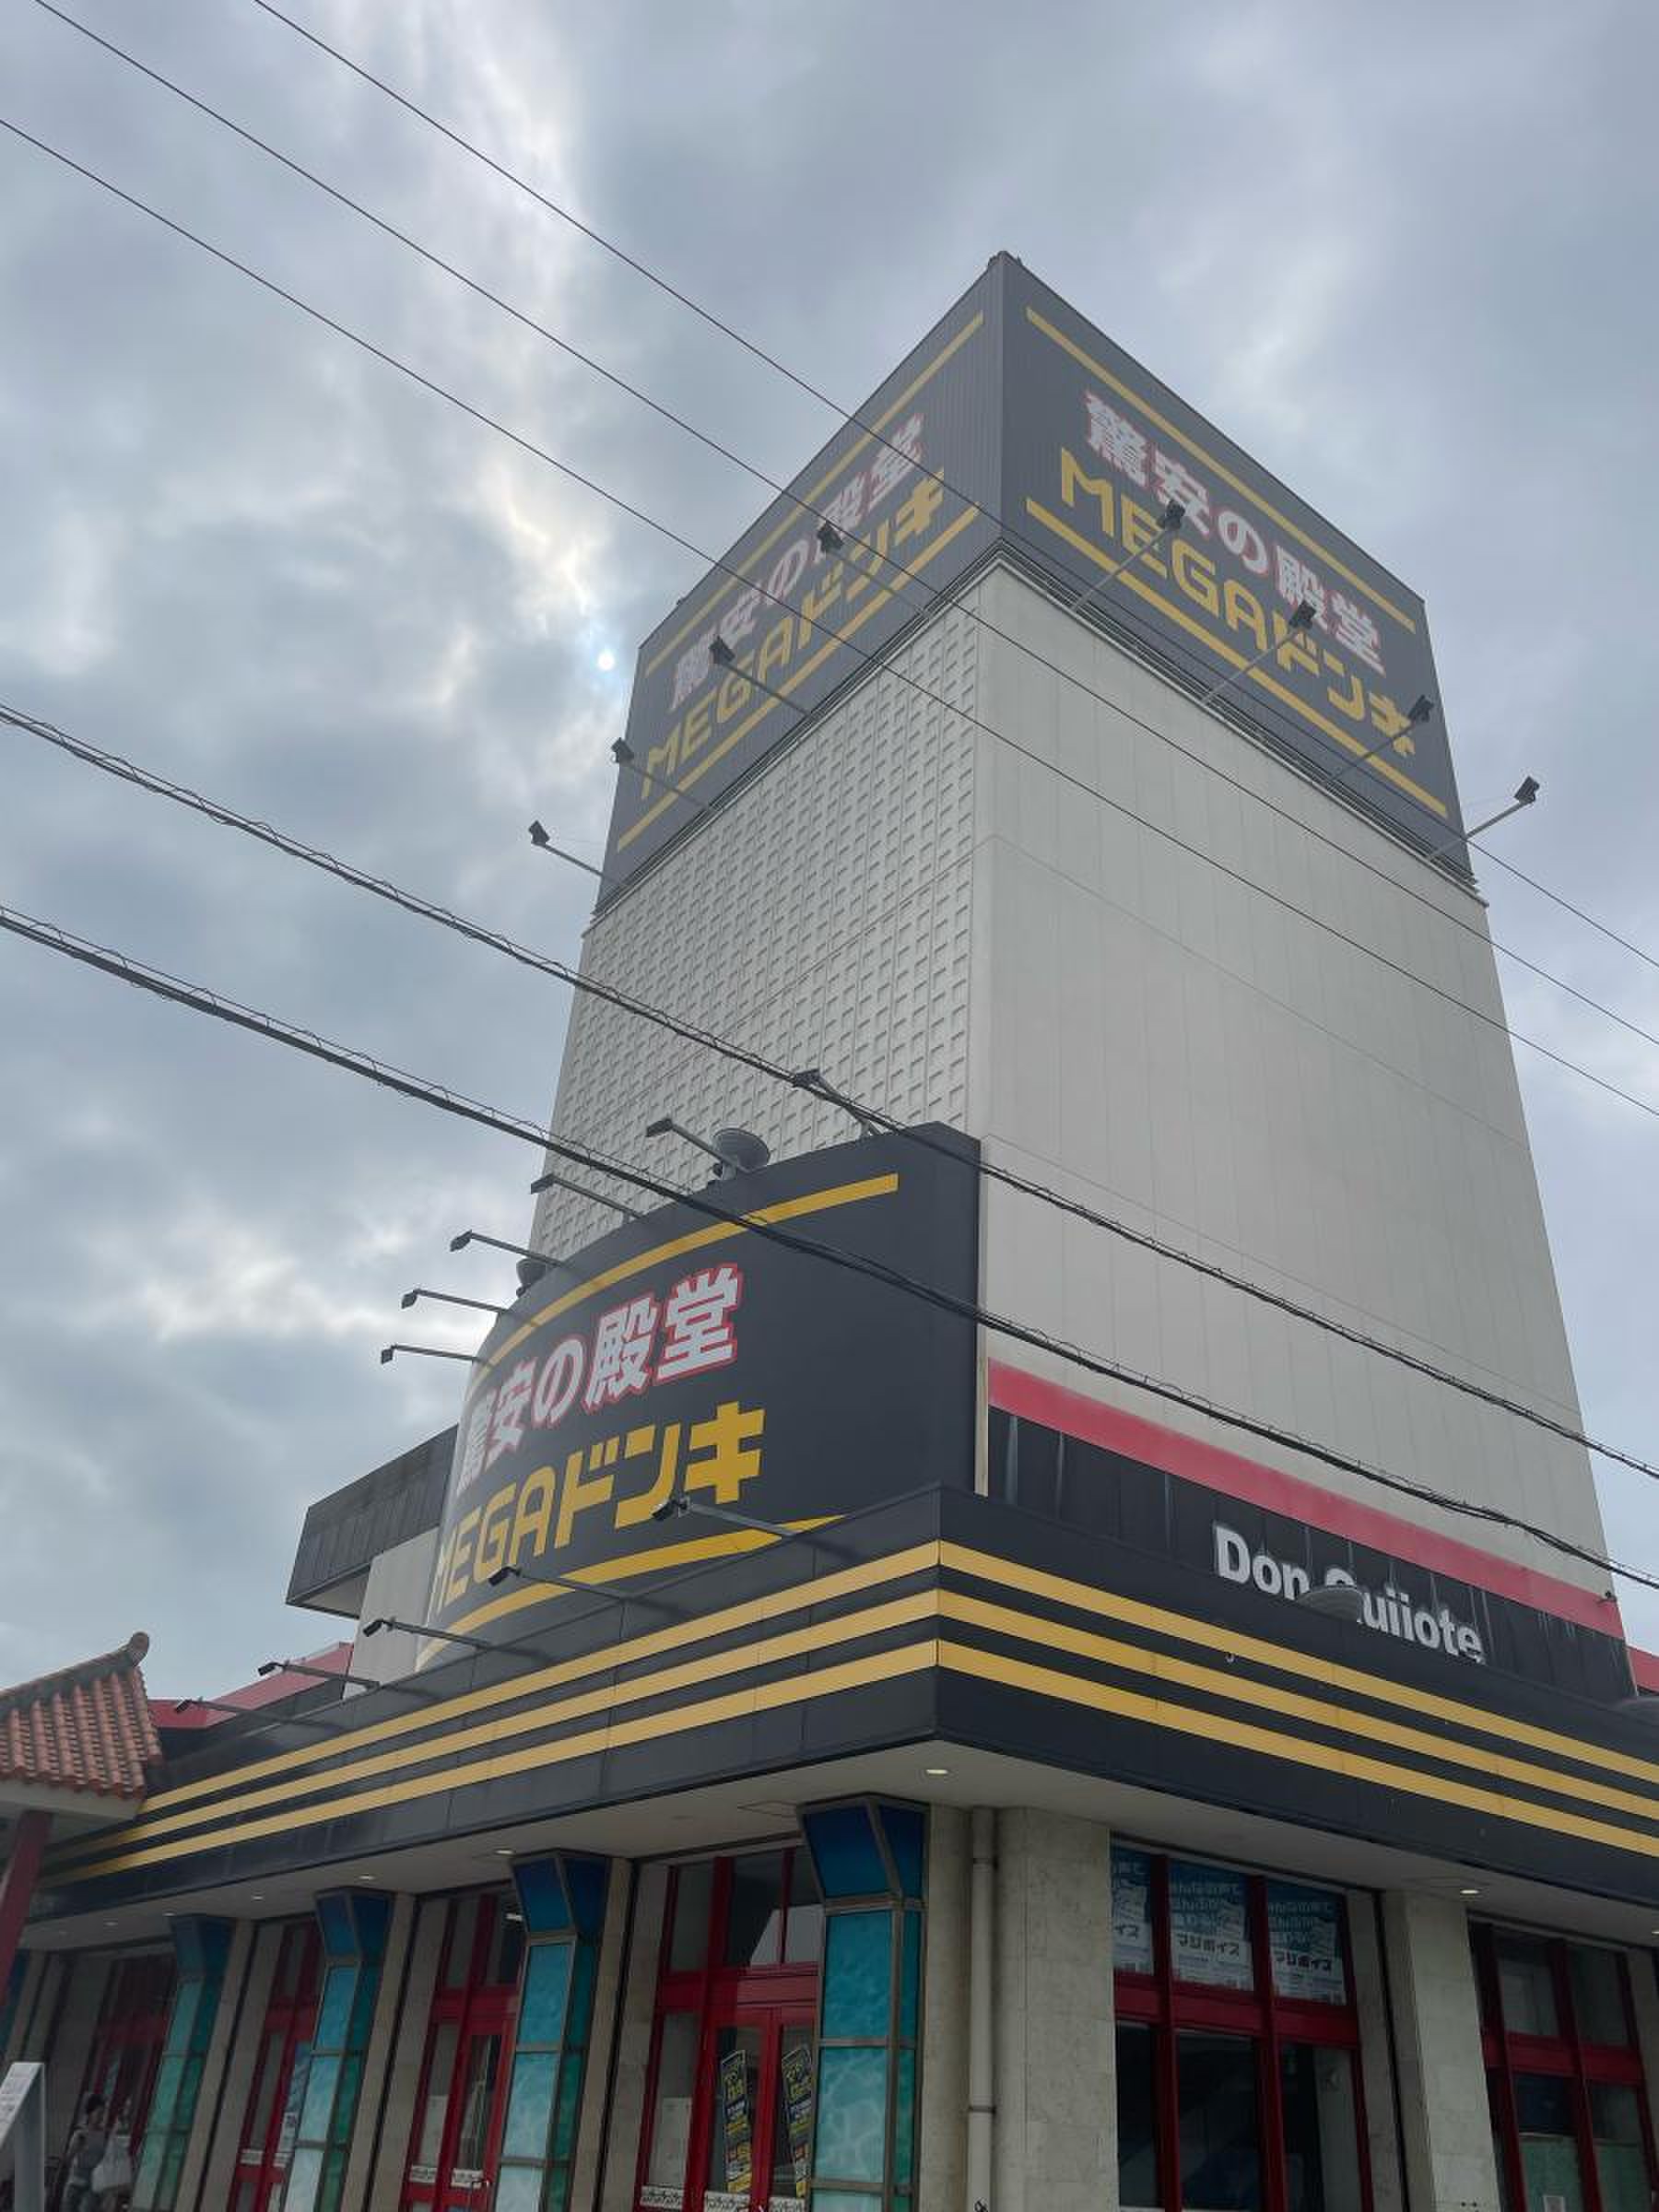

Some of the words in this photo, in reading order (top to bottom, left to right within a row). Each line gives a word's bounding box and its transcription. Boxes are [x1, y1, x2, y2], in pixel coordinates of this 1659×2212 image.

[641, 466, 945, 801] MEGAドンキ
[1061, 446, 1417, 756] MEGAドンキ
[1083, 388, 1386, 680] 驚安の殿堂
[455, 1261, 745, 1497] 驚安の殿堂
[1215, 1525, 1311, 1600] Don
[1325, 1568, 1486, 1665] uijote
